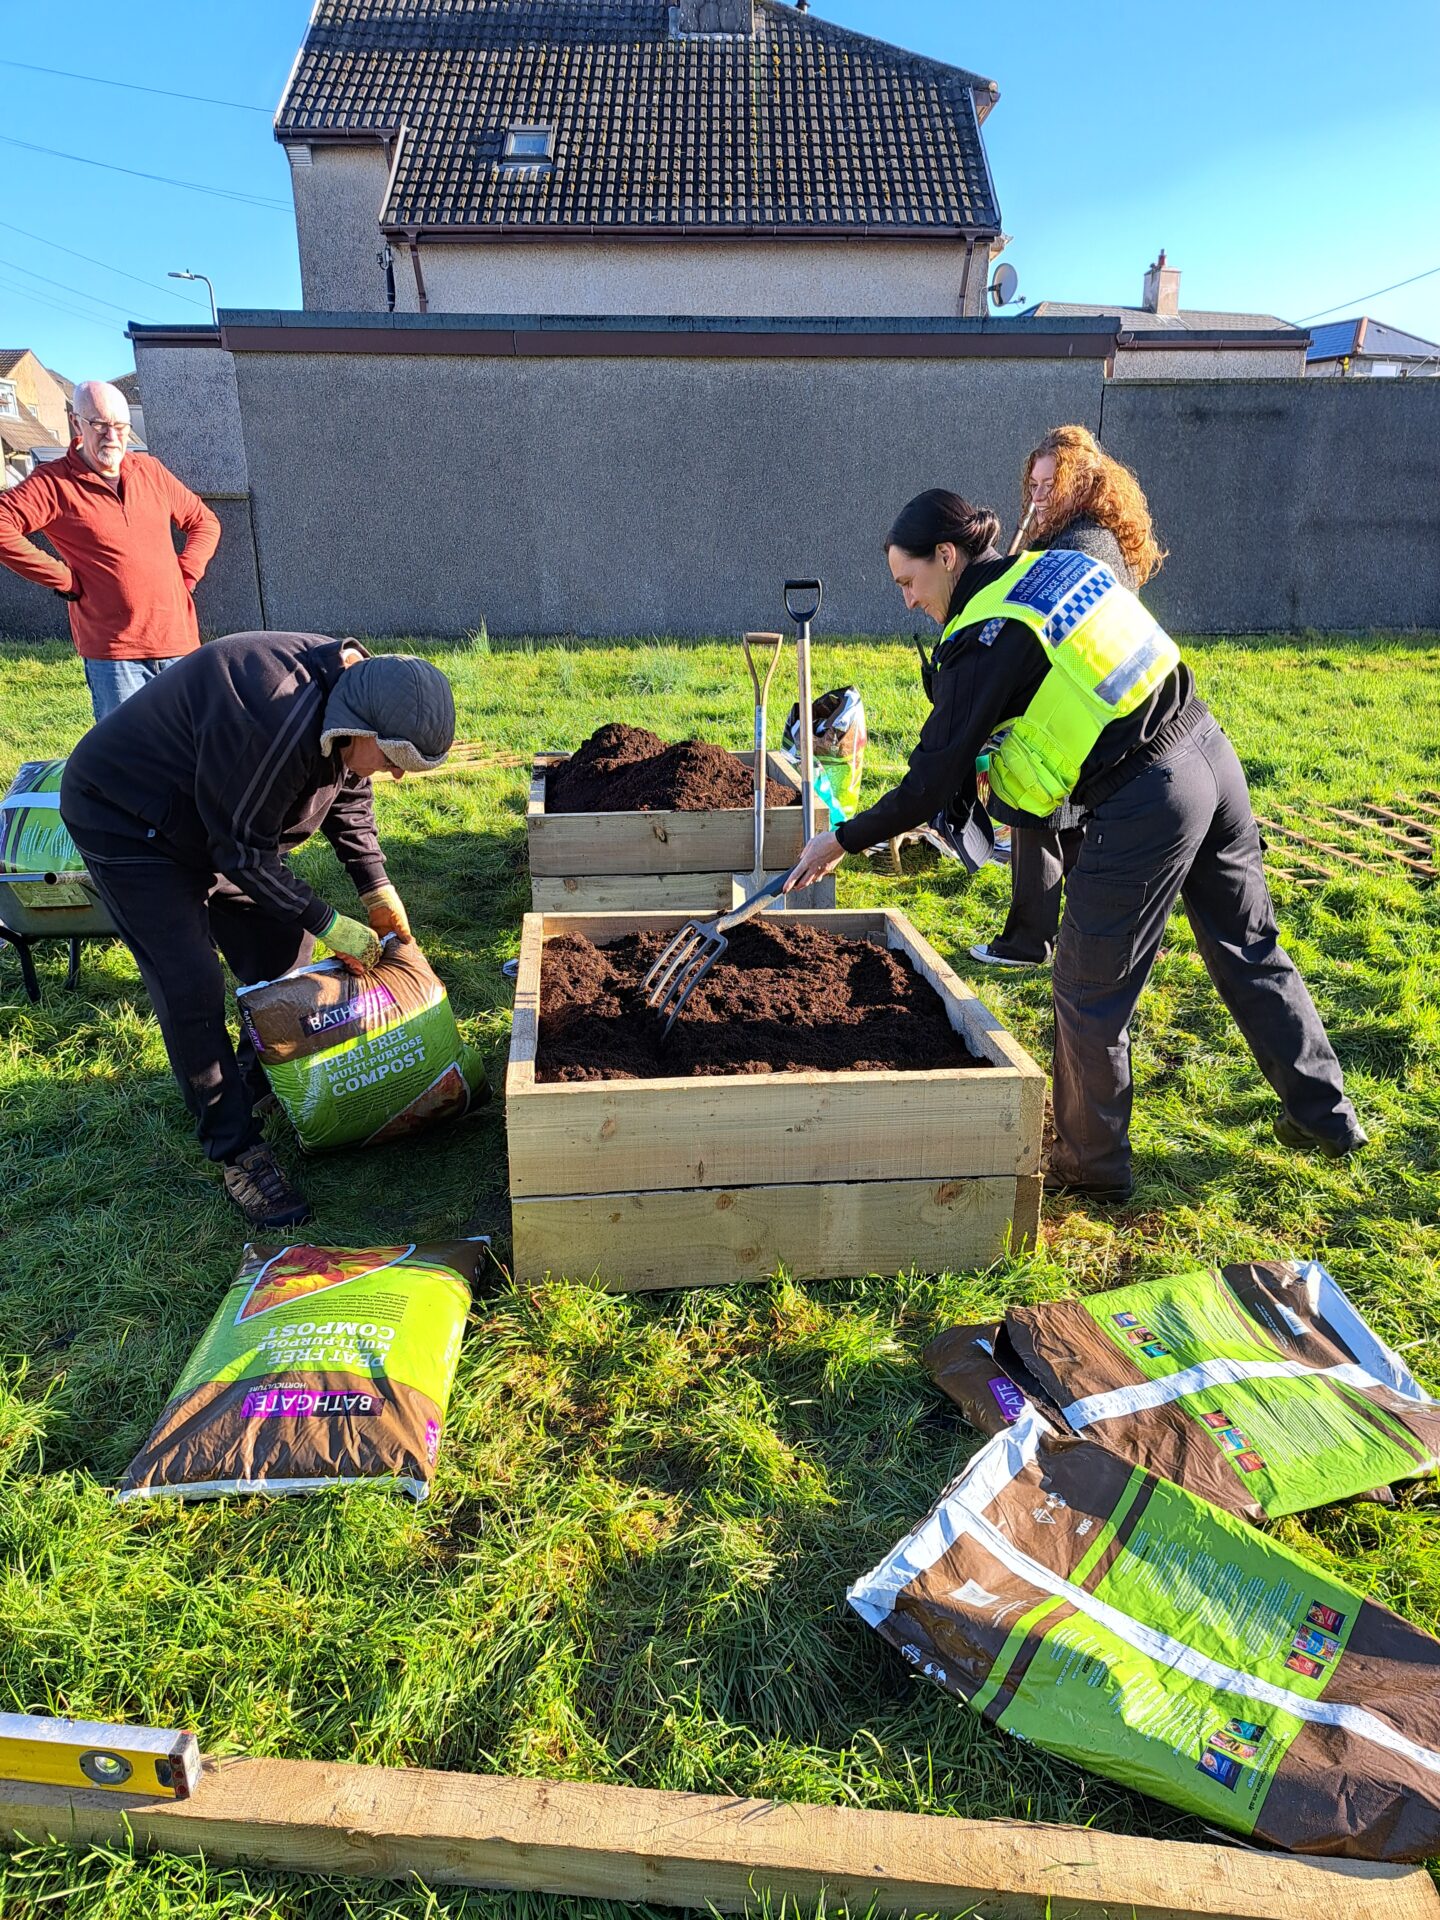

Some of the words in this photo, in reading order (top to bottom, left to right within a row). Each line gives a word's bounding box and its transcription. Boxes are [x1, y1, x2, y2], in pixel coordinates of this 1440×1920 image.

[1018, 569, 1052, 602] CYMUNEDOL
[1038, 579, 1060, 600] POLICE
[1057, 556, 1086, 580] COMMUNITY
[1048, 578, 1074, 603] SUPPORT
[324, 1043, 367, 1072] PEAT
[367, 1025, 409, 1054] FREE
[327, 1035, 424, 1083] MULTI-PURPOSE
[331, 1047, 427, 1098] COMPOST
[261, 1321, 396, 1340] COMPOST
[256, 1335, 391, 1352] MULTI-PURPOSE
[266, 1347, 327, 1366] FREE
[327, 1347, 385, 1367] PEAT
[247, 1380, 307, 1392] HORTICULTURE
[254, 1393, 373, 1414] BATHGATE
